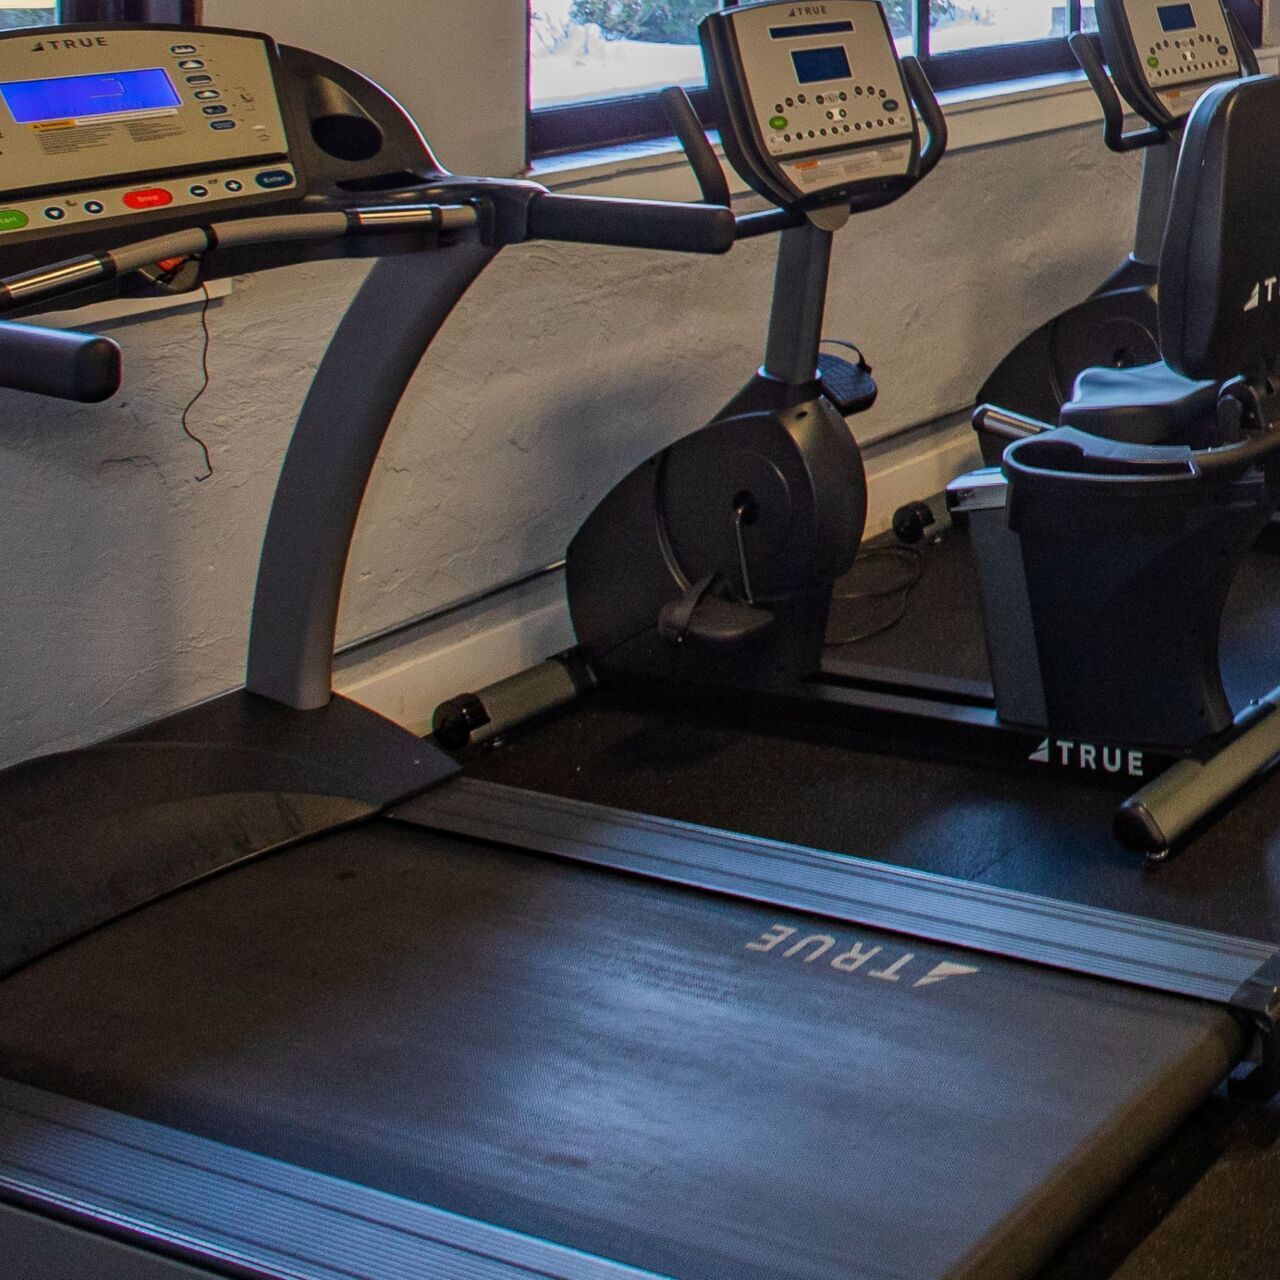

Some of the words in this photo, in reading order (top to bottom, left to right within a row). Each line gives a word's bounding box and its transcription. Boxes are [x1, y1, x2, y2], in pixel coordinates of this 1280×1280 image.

[797, 5, 827, 16] TRUE
[47, 36, 109, 50] TRUE
[1056, 740, 1144, 777] TRUE
[744, 924, 915, 982] TRUE
